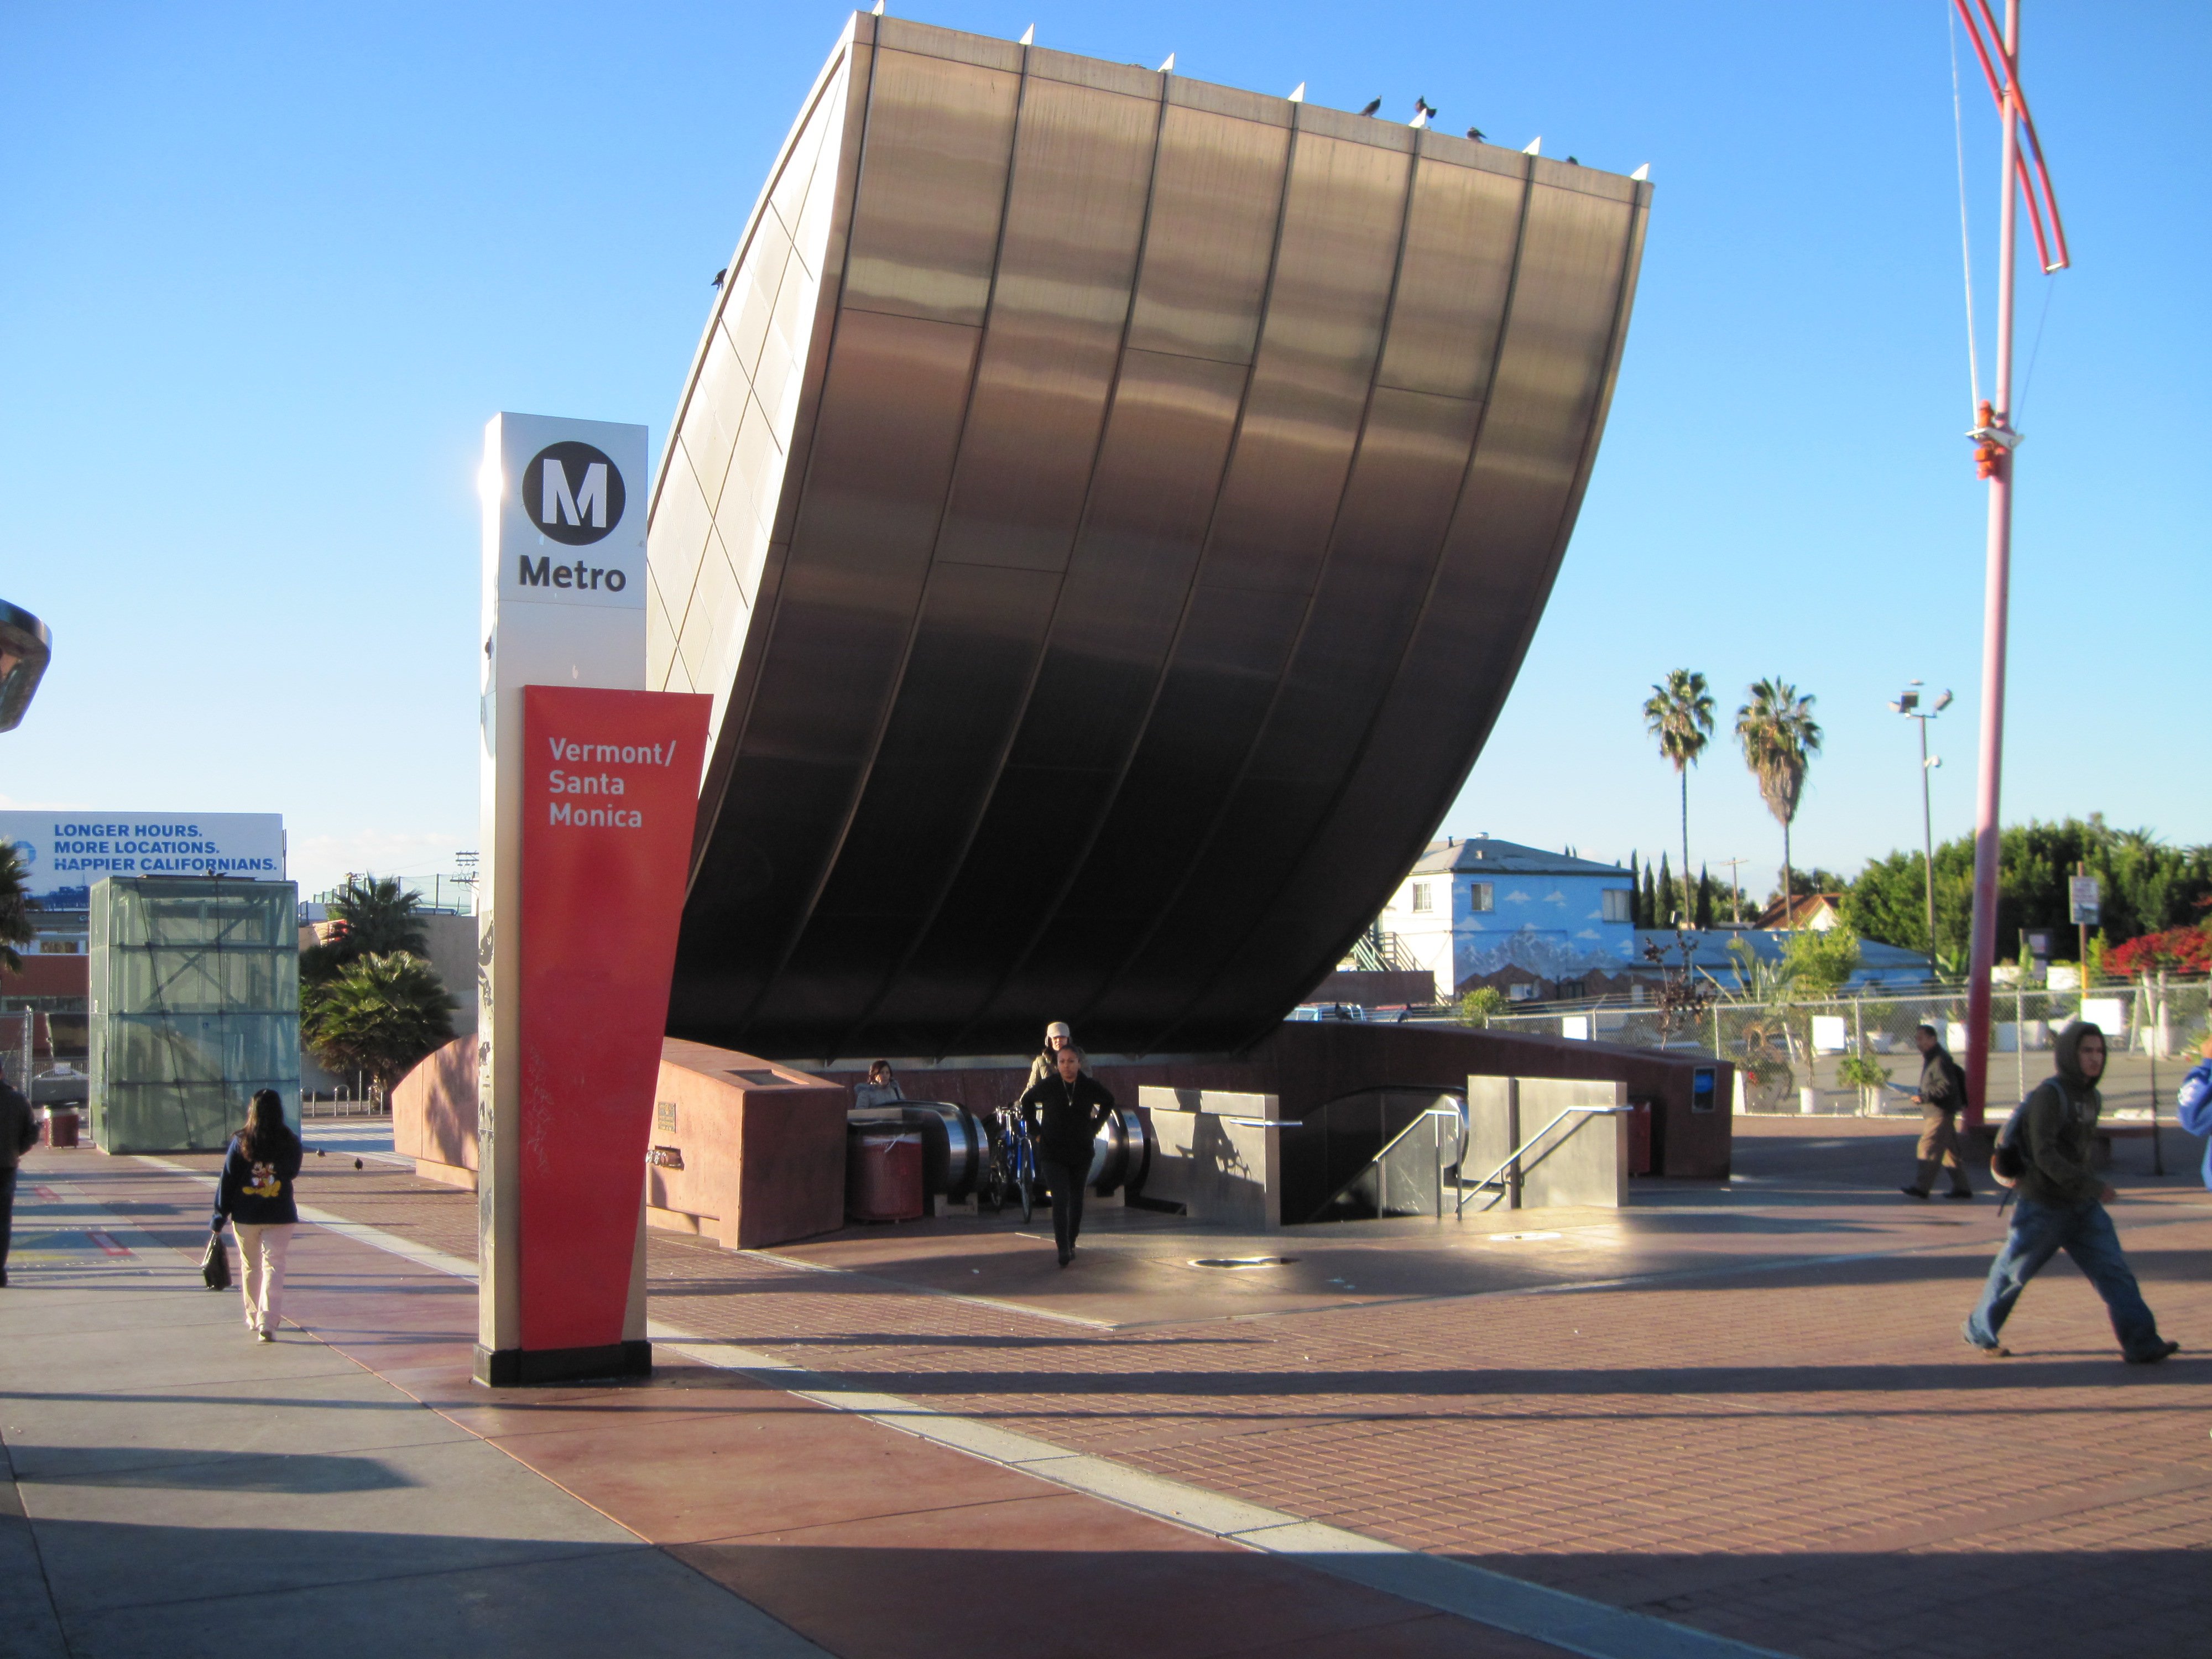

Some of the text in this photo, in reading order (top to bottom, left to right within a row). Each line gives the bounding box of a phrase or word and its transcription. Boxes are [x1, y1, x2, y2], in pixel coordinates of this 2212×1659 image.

[542, 458, 607, 528] M
[519, 555, 627, 592] Metro
[549, 737, 676, 767] Vermont/
[549, 770, 625, 795] Santa
[549, 802, 643, 828] Monica
[55, 825, 202, 837] LONGER HOURS.
[55, 841, 220, 854] MORE LOCATIONS.
[54, 858, 277, 870] HAPPIER CALIFORNIANS.
